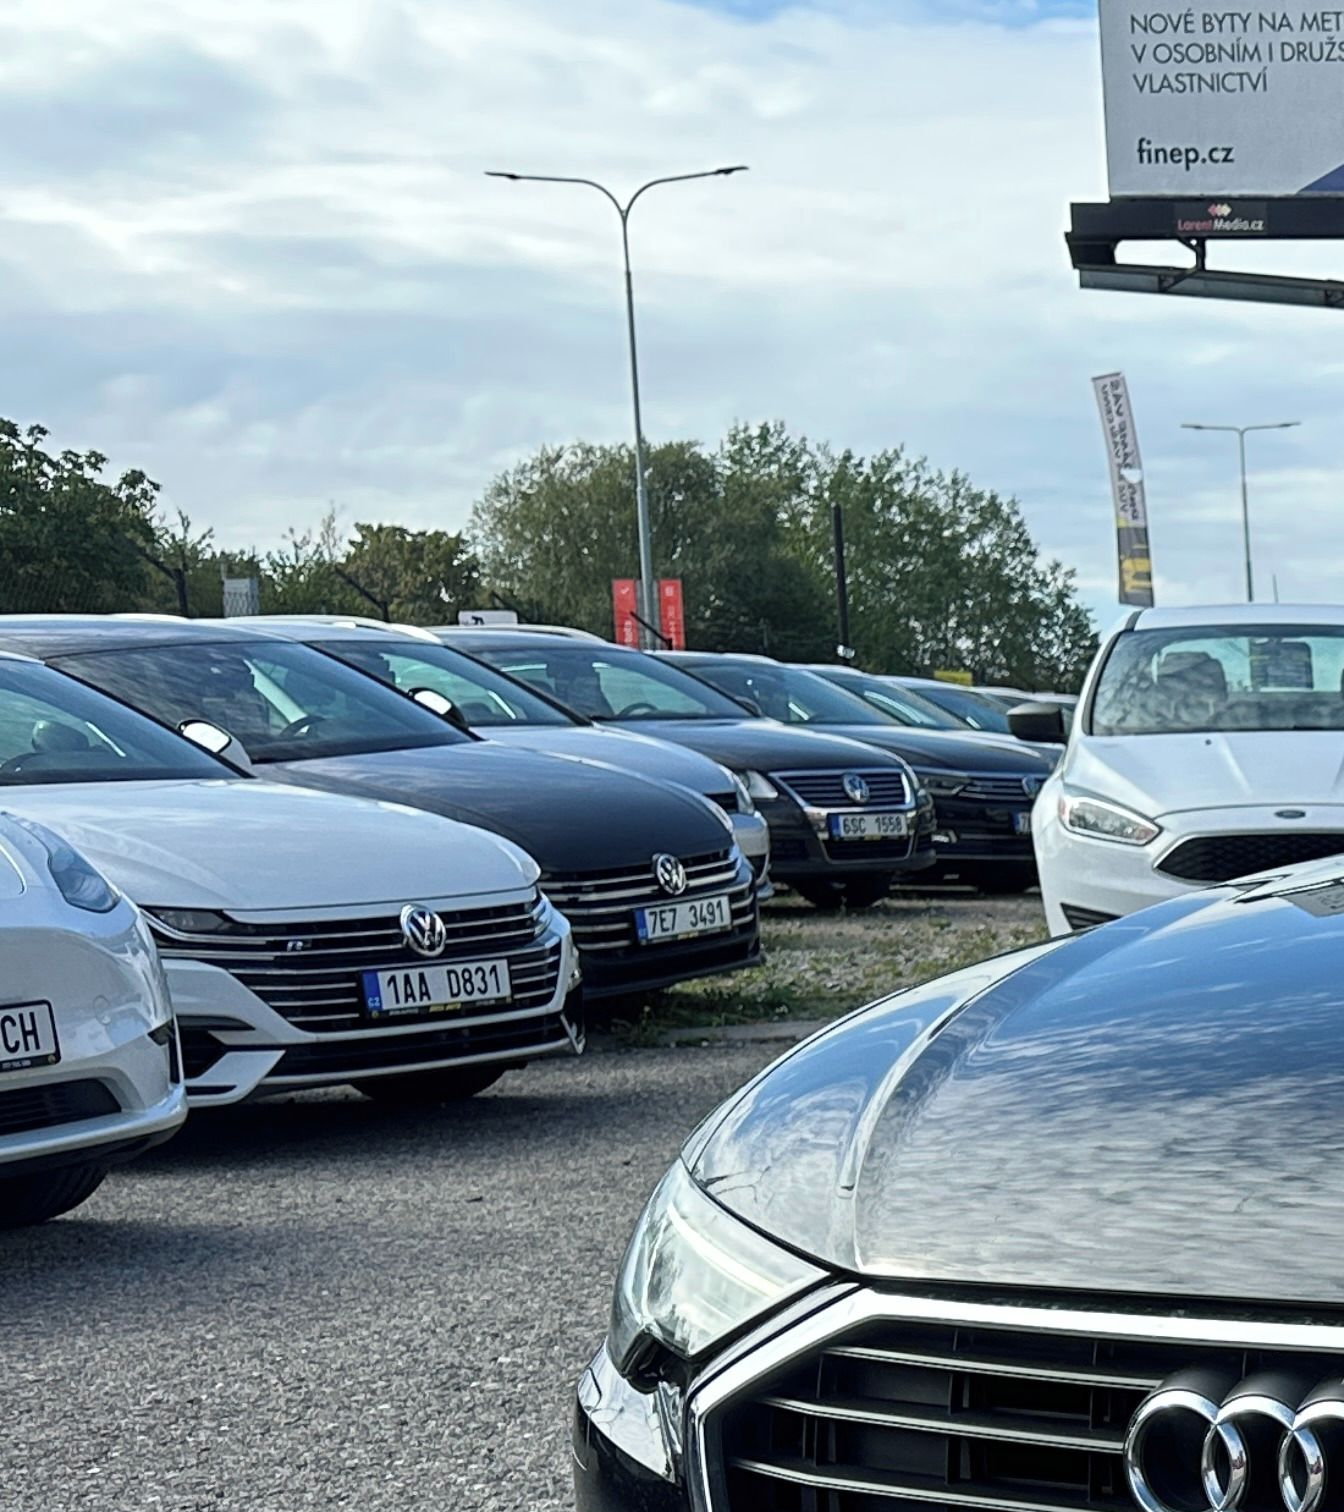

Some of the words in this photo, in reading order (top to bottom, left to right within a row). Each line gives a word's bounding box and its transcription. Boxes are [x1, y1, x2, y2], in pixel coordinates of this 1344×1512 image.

[1130, 8, 1195, 34] NOVÉ
[1202, 12, 1252, 34] BYTY
[1258, 12, 1293, 33] NA
[1131, 43, 1147, 64] V
[1152, 36, 1262, 64] OSOBNÍM
[1268, 43, 1274, 62] I
[1132, 66, 1269, 94] VLASTNICTVÍ
[1137, 137, 1235, 171] finep.cz
[648, 908, 677, 934] 7E7
[688, 899, 724, 928] 3491
[387, 971, 432, 1005] 1AA
[446, 964, 502, 999] D831
[0, 1011, 41, 1054] CH
